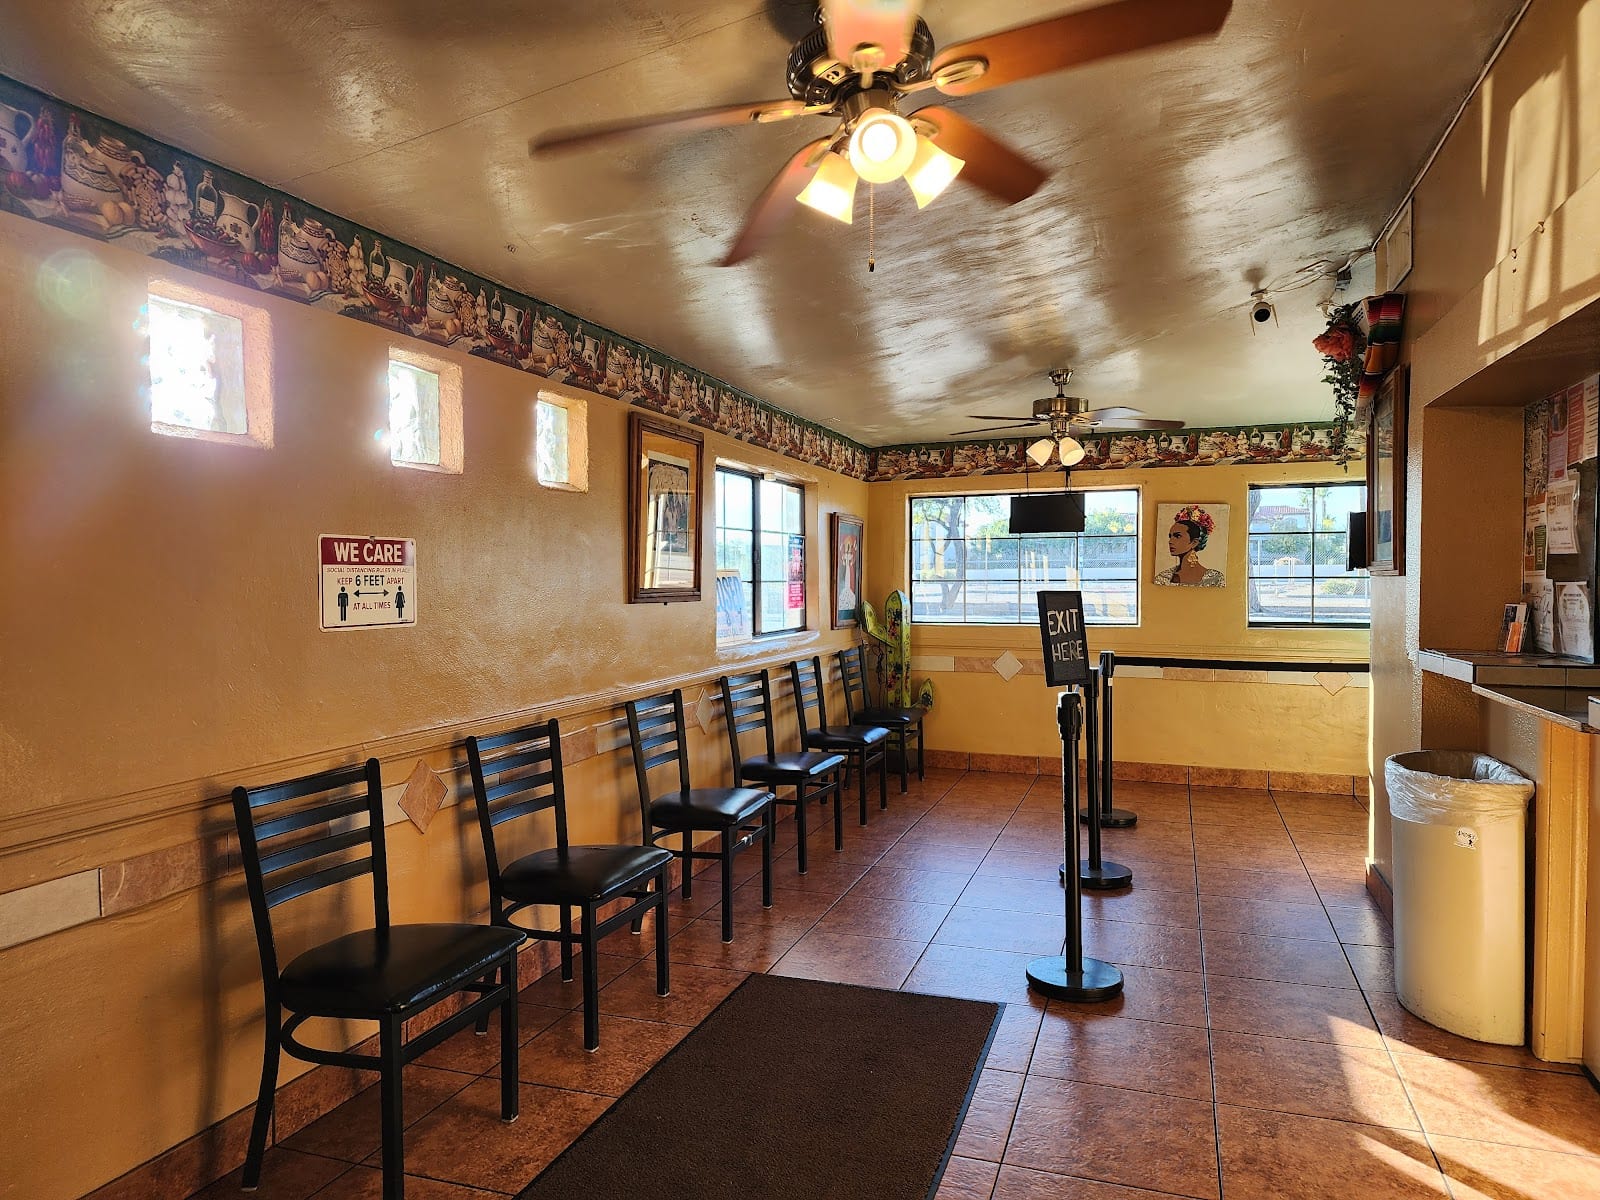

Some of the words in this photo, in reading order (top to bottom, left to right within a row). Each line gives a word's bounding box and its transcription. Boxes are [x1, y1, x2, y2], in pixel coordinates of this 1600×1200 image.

[333, 541, 360, 562] WE
[362, 542, 403, 563] CARE
[337, 577, 353, 586] KEEP
[355, 574, 361, 587] 6
[363, 574, 385, 587] FEET
[386, 577, 404, 585] APART
[352, 602, 361, 611] AT
[361, 602, 373, 610] ALL
[374, 601, 391, 610] TIMES
[1047, 608, 1079, 636] EXIT
[1051, 640, 1085, 662] HERE
